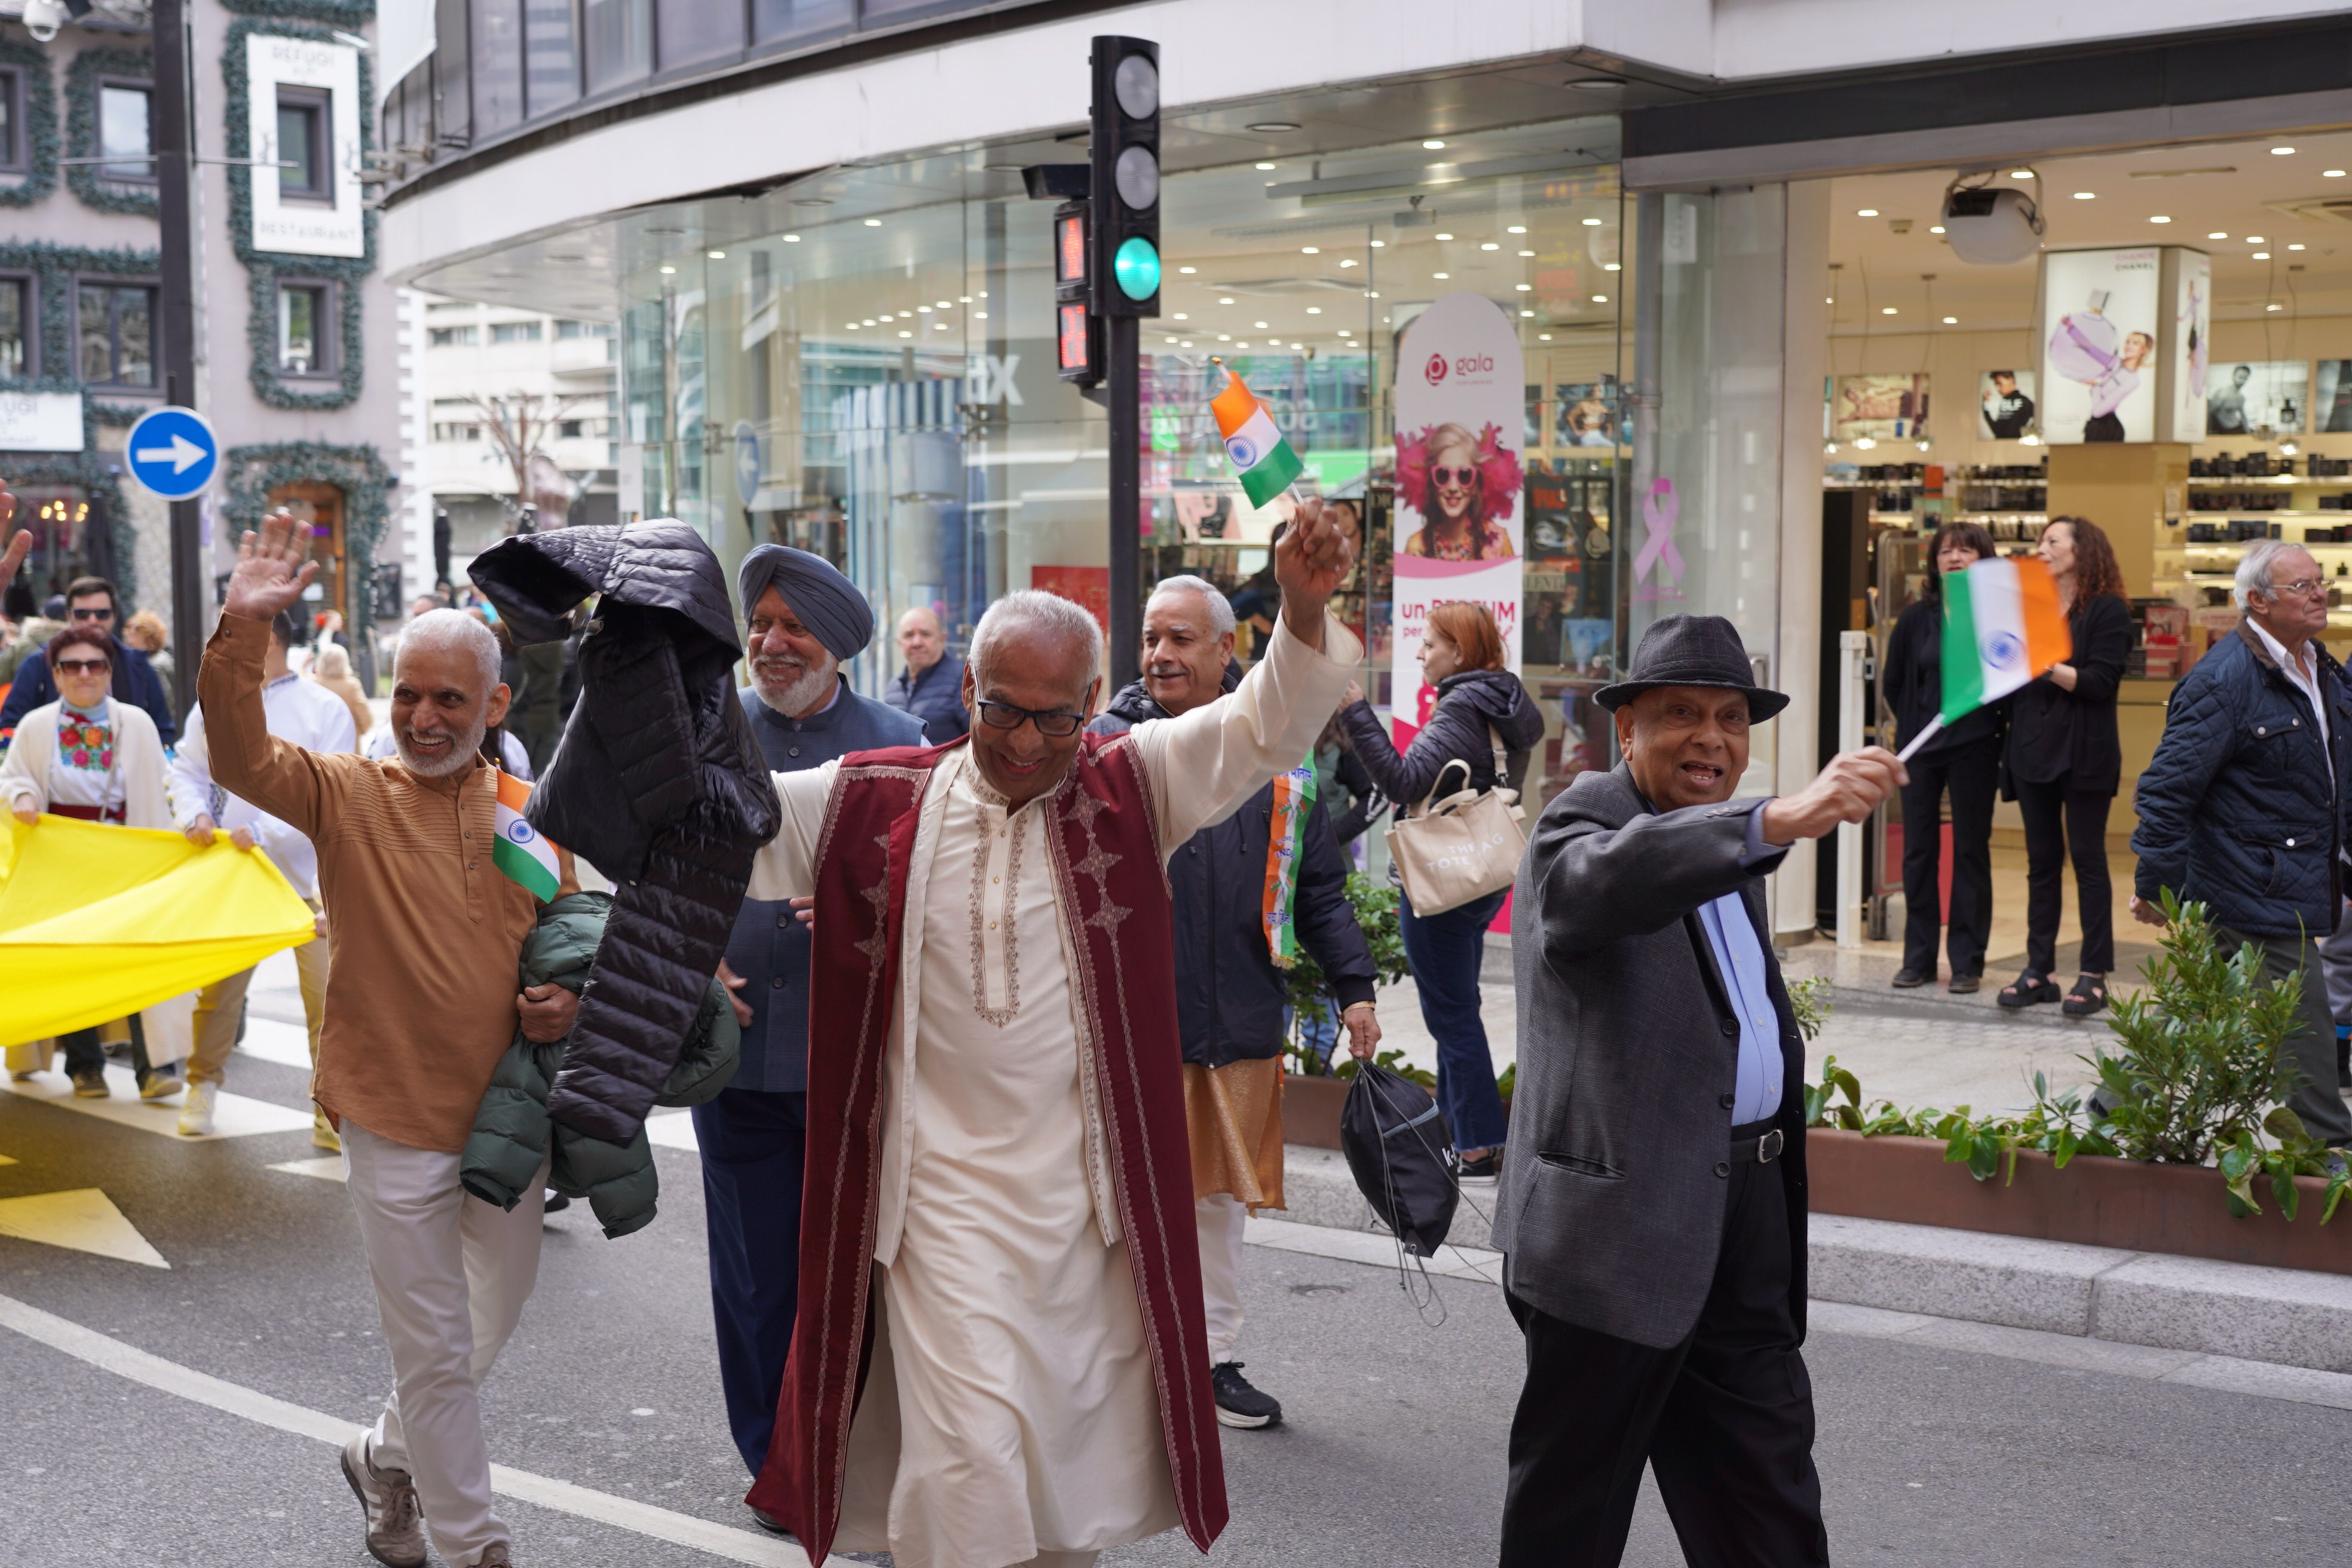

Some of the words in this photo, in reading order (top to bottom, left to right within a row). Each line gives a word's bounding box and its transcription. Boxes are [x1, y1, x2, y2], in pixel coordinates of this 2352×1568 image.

[1456, 353, 1493, 376] gala
[1402, 604, 1425, 618] un
[1403, 627, 1423, 639] per
[1426, 856, 1471, 872] TOTE
